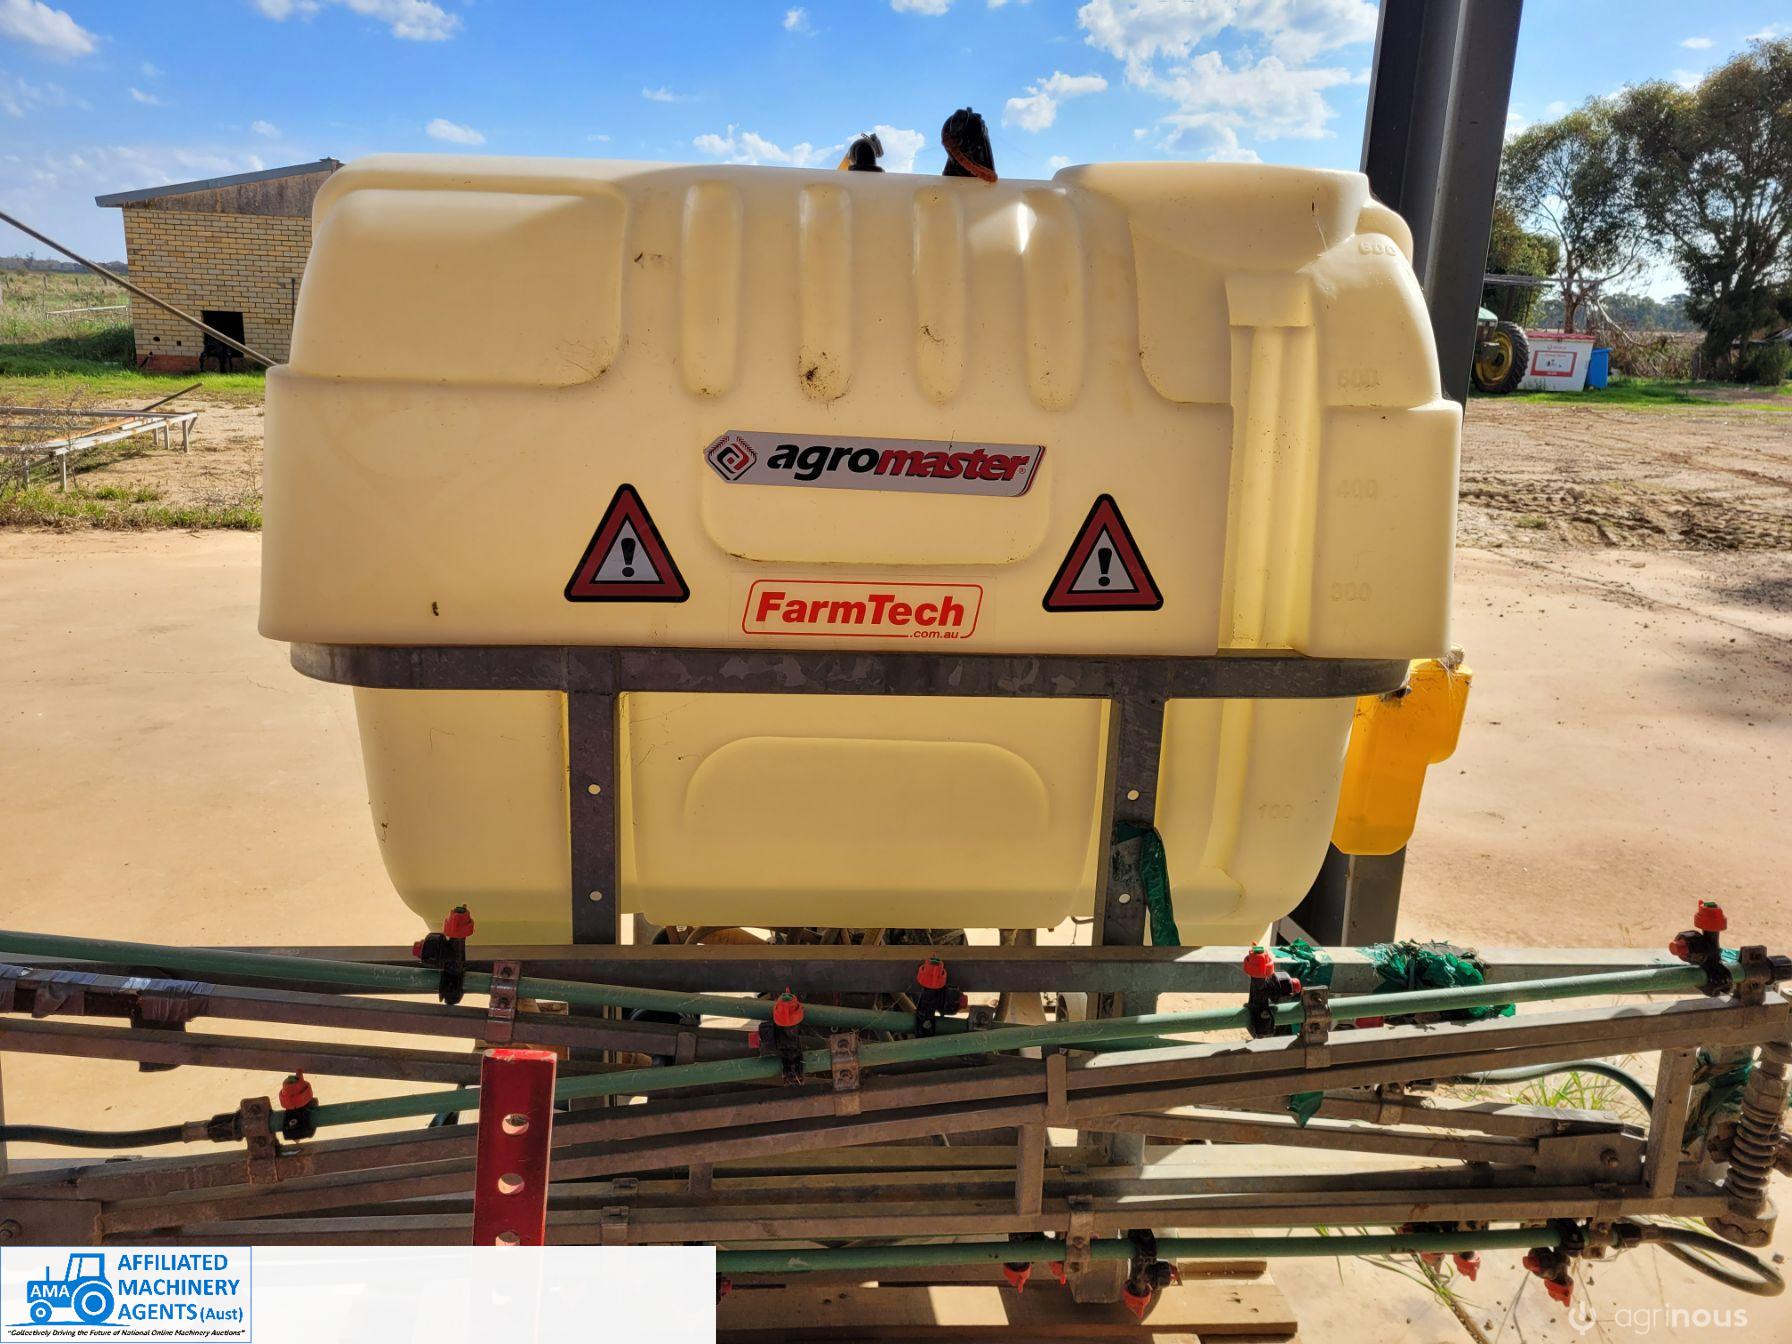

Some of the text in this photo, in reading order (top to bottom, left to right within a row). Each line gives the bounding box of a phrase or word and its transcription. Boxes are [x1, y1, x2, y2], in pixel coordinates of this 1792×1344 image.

[767, 443, 1029, 481] agromaster
[1330, 580, 1373, 602] 300
[756, 592, 965, 627] FarmTech
